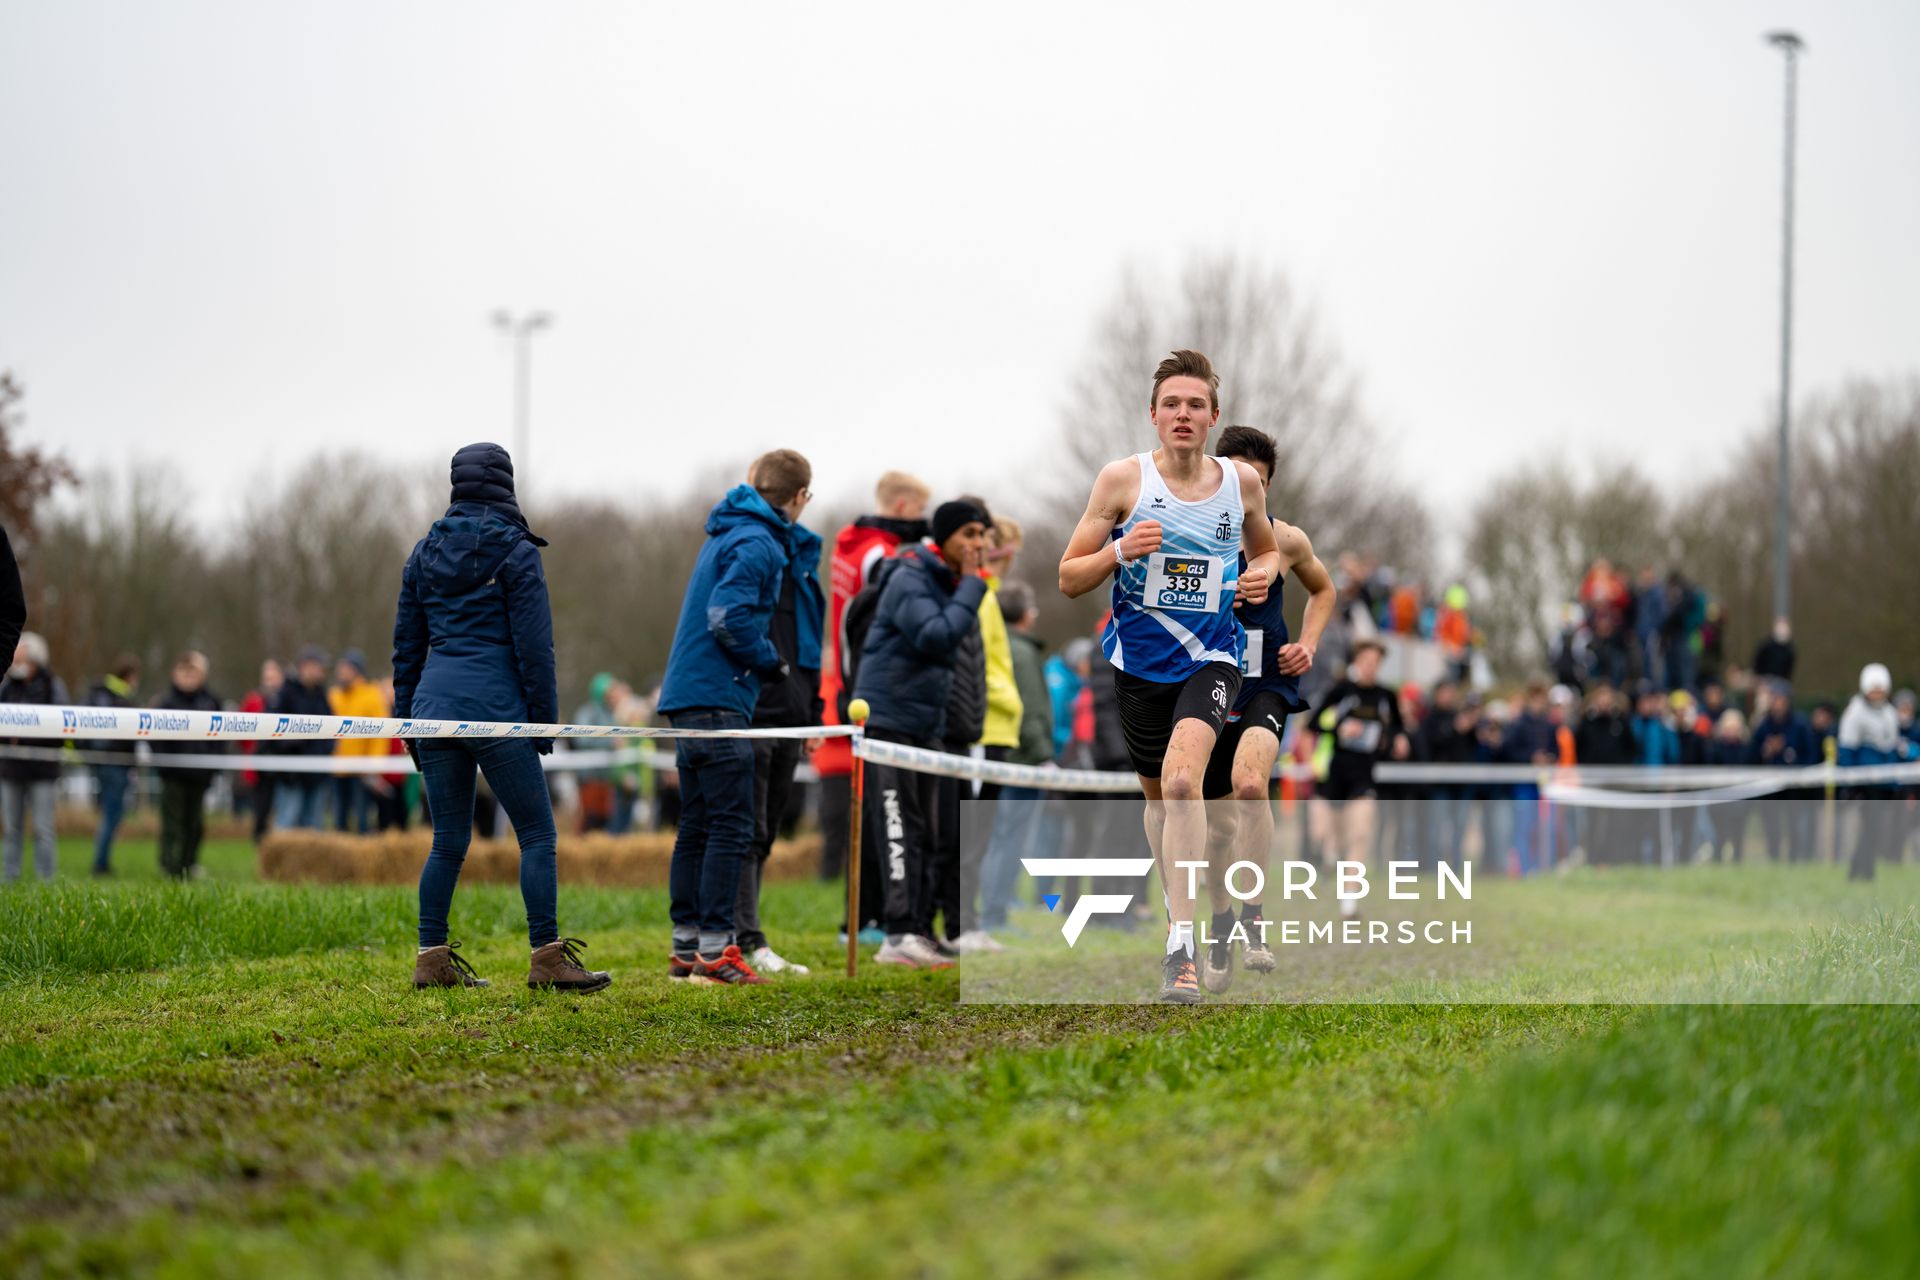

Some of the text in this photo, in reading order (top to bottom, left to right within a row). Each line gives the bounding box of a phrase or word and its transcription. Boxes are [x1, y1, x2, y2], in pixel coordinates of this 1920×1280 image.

[1187, 564, 1205, 575] GLS
[1166, 575, 1201, 592] 339
[1178, 593, 1205, 603] PLAN
[79, 710, 119, 729] Volksbank
[153, 712, 191, 731] Volksbank
[223, 715, 260, 733] Volksbank
[288, 718, 323, 734] Volksbank
[351, 720, 384, 735] Volksbank
[409, 722, 442, 735] Volksbank
[882, 789, 905, 880] NIKE AIR
